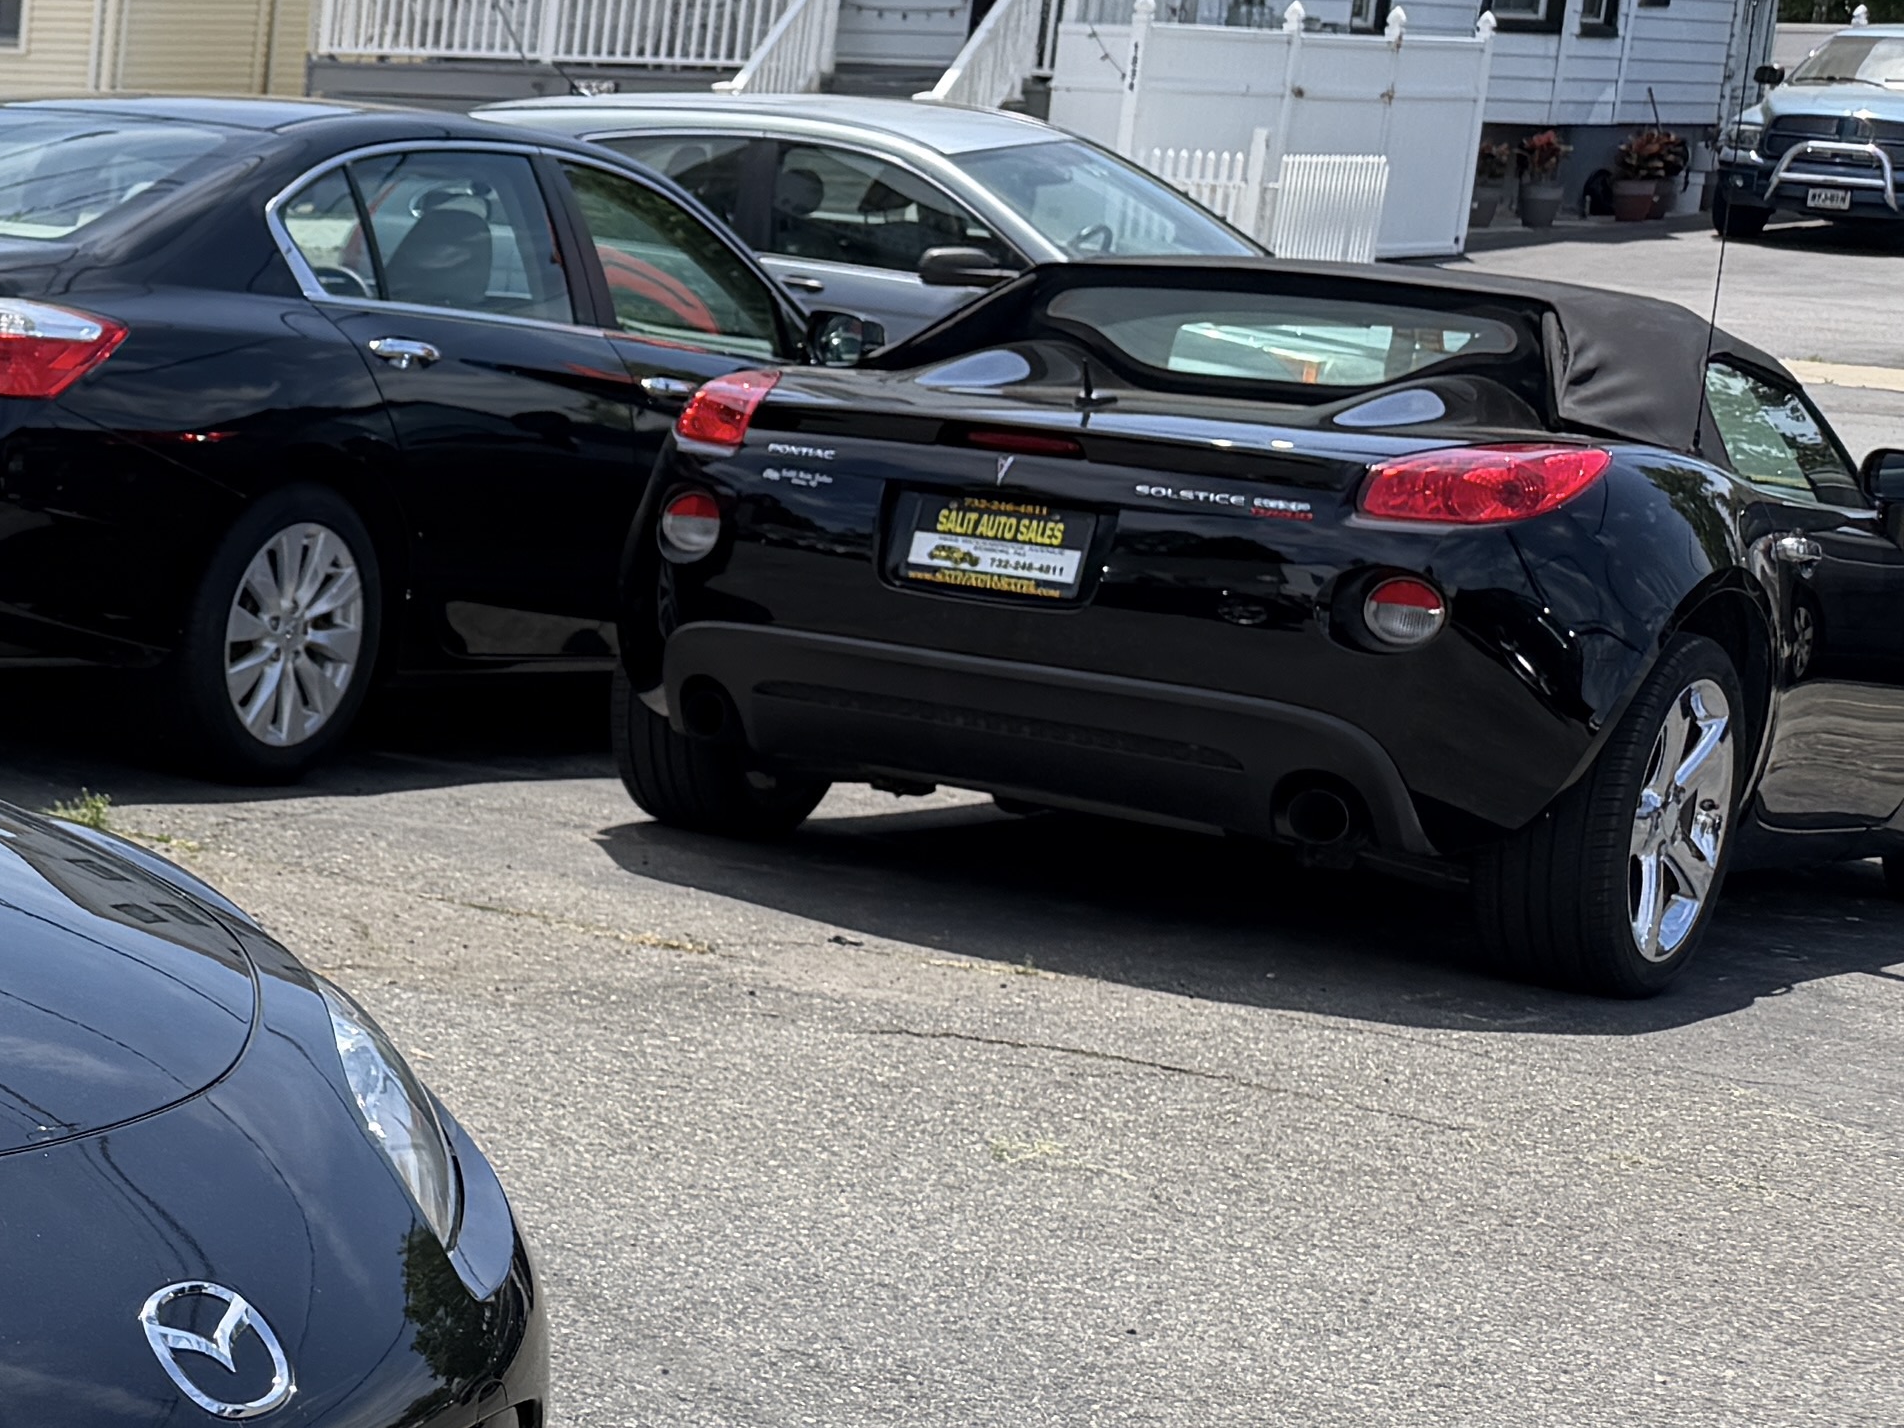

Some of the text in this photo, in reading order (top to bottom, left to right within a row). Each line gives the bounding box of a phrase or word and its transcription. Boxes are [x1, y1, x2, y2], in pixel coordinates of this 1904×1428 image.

[767, 442, 836, 460] PONTIAC
[1135, 484, 1245, 507] SOLSTICE
[936, 508, 979, 536] SALIT
[975, 513, 1018, 541] AUTO
[1017, 518, 1065, 546] SALES
